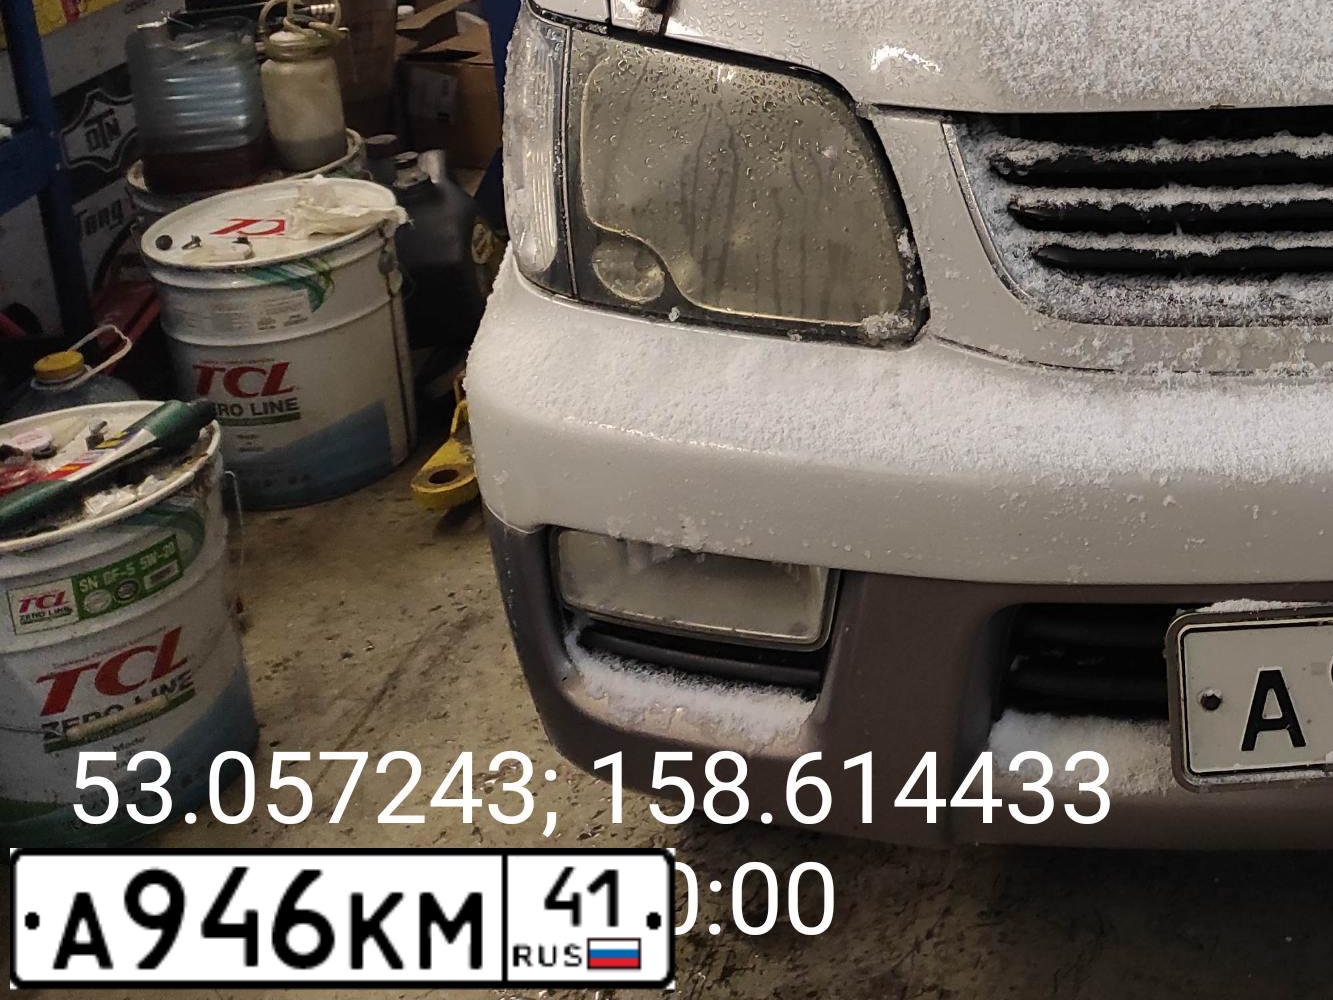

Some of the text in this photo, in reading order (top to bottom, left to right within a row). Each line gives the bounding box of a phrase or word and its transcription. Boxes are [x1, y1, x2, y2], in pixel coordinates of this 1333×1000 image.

[192, 361, 298, 398] TCL
[250, 397, 299, 416] LINE
[79, 575, 99, 593] SN
[18, 590, 71, 613] TCL
[36, 626, 188, 717] TCL
